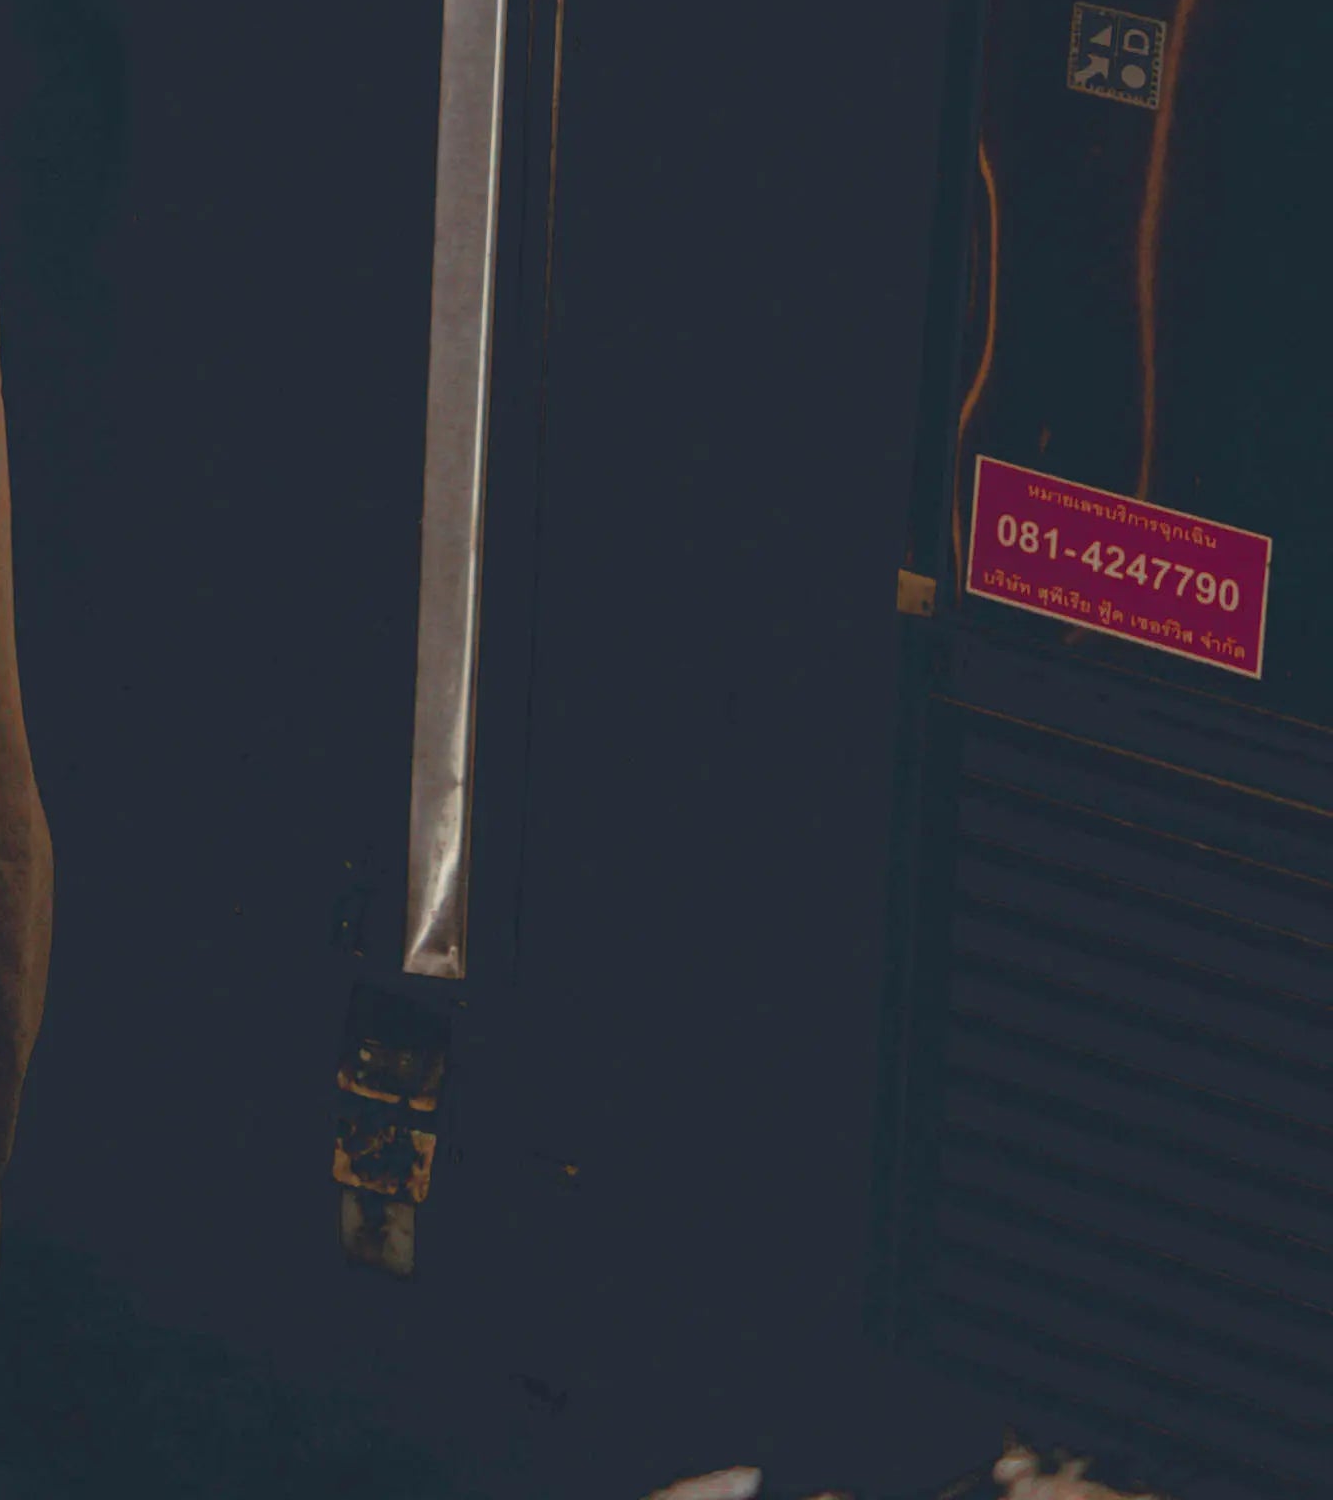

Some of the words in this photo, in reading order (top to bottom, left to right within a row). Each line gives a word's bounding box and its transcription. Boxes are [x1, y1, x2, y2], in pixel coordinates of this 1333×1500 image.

[983, 570, 1031, 596] บริษัท
[997, 514, 1240, 612] 081-4247790
